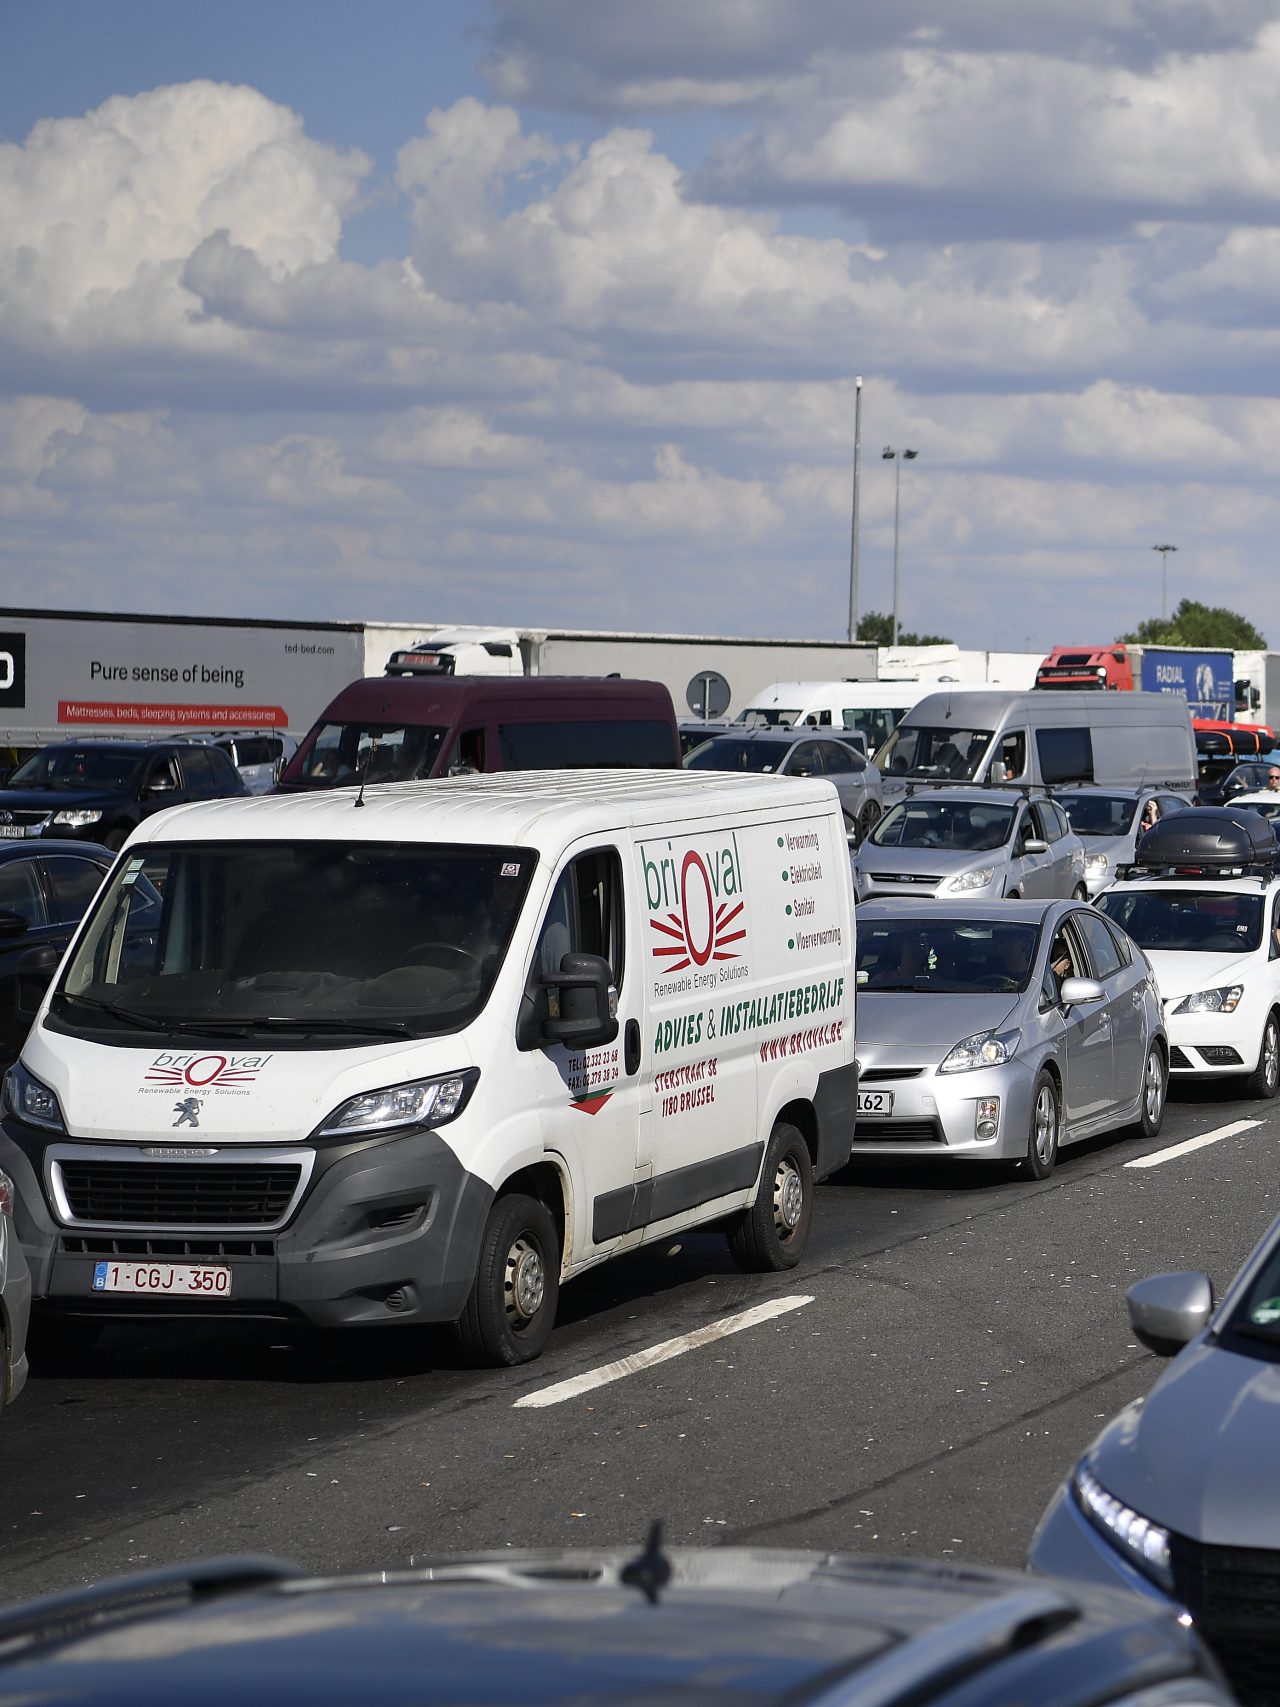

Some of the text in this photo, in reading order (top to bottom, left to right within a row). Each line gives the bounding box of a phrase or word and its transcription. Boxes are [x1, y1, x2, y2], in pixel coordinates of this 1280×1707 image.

[284, 643, 335, 655] ted-bed.com
[90, 660, 244, 688] Pure sense of being
[1156, 665, 1185, 683] RADIAL
[66, 704, 276, 721] Mattresses, beds, sleeping systems and accessories
[785, 829, 819, 851] Verwarming
[794, 896, 815, 917] Sanitair
[796, 924, 841, 950] Vloerverwarming
[654, 964, 749, 998] Renewable Energy Solutions
[654, 977, 844, 1054] ADVIES & INSTALLATIEBEDRIJF
[760, 1021, 843, 1063] WWW.BRIOVAL.BE
[568, 1058, 582, 1072] TEL:
[583, 1053, 602, 1069] 02.332
[603, 1051, 610, 1064] 23
[568, 1076, 582, 1090] FAX:
[655, 1058, 718, 1093] STERSTRAAT 38
[138, 1087, 251, 1096] Renewable Energy Solutions
[662, 1084, 715, 1118] 1180 BRUSSEL
[96, 1277, 105, 1287] B
[111, 1266, 228, 1292] 1-CGJ-350
